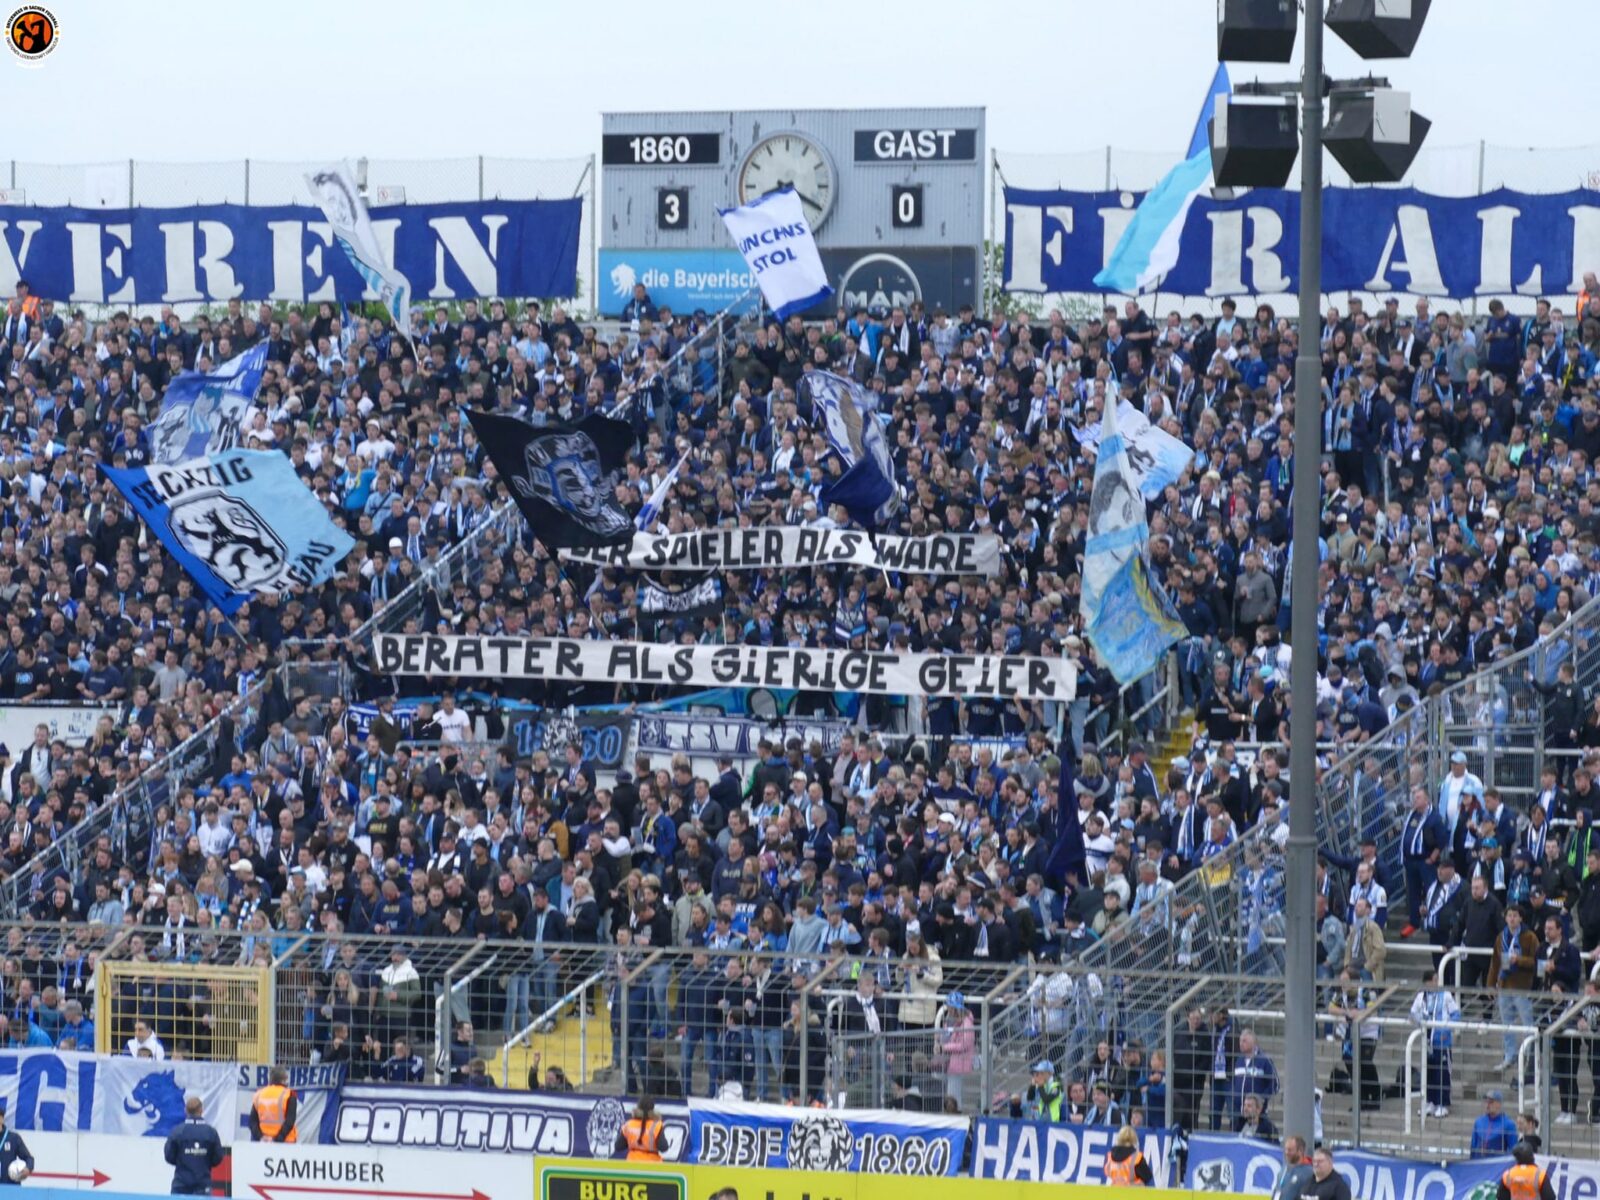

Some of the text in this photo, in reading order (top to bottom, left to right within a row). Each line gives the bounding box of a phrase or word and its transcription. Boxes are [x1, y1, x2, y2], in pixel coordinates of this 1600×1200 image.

[630, 136, 691, 163] 1860
[873, 129, 956, 159] GAST
[664, 194, 680, 224] 3
[898, 192, 915, 223] 0
[642, 268, 670, 288] die
[845, 290, 914, 309] MAN
[644, 527, 783, 566] SPIELER
[795, 529, 863, 563] ALS
[874, 536, 977, 572] WARE
[381, 637, 583, 677] BERATER
[607, 645, 694, 683] ALS
[665, 721, 741, 751] TSV
[337, 1103, 573, 1154] COMITIVA
[699, 1122, 783, 1168] BBF
[856, 1132, 951, 1177] 1860
[974, 1122, 1171, 1189] HADEN
[263, 1157, 385, 1183] SAMHUBER
[580, 1181, 648, 1200] BURG
